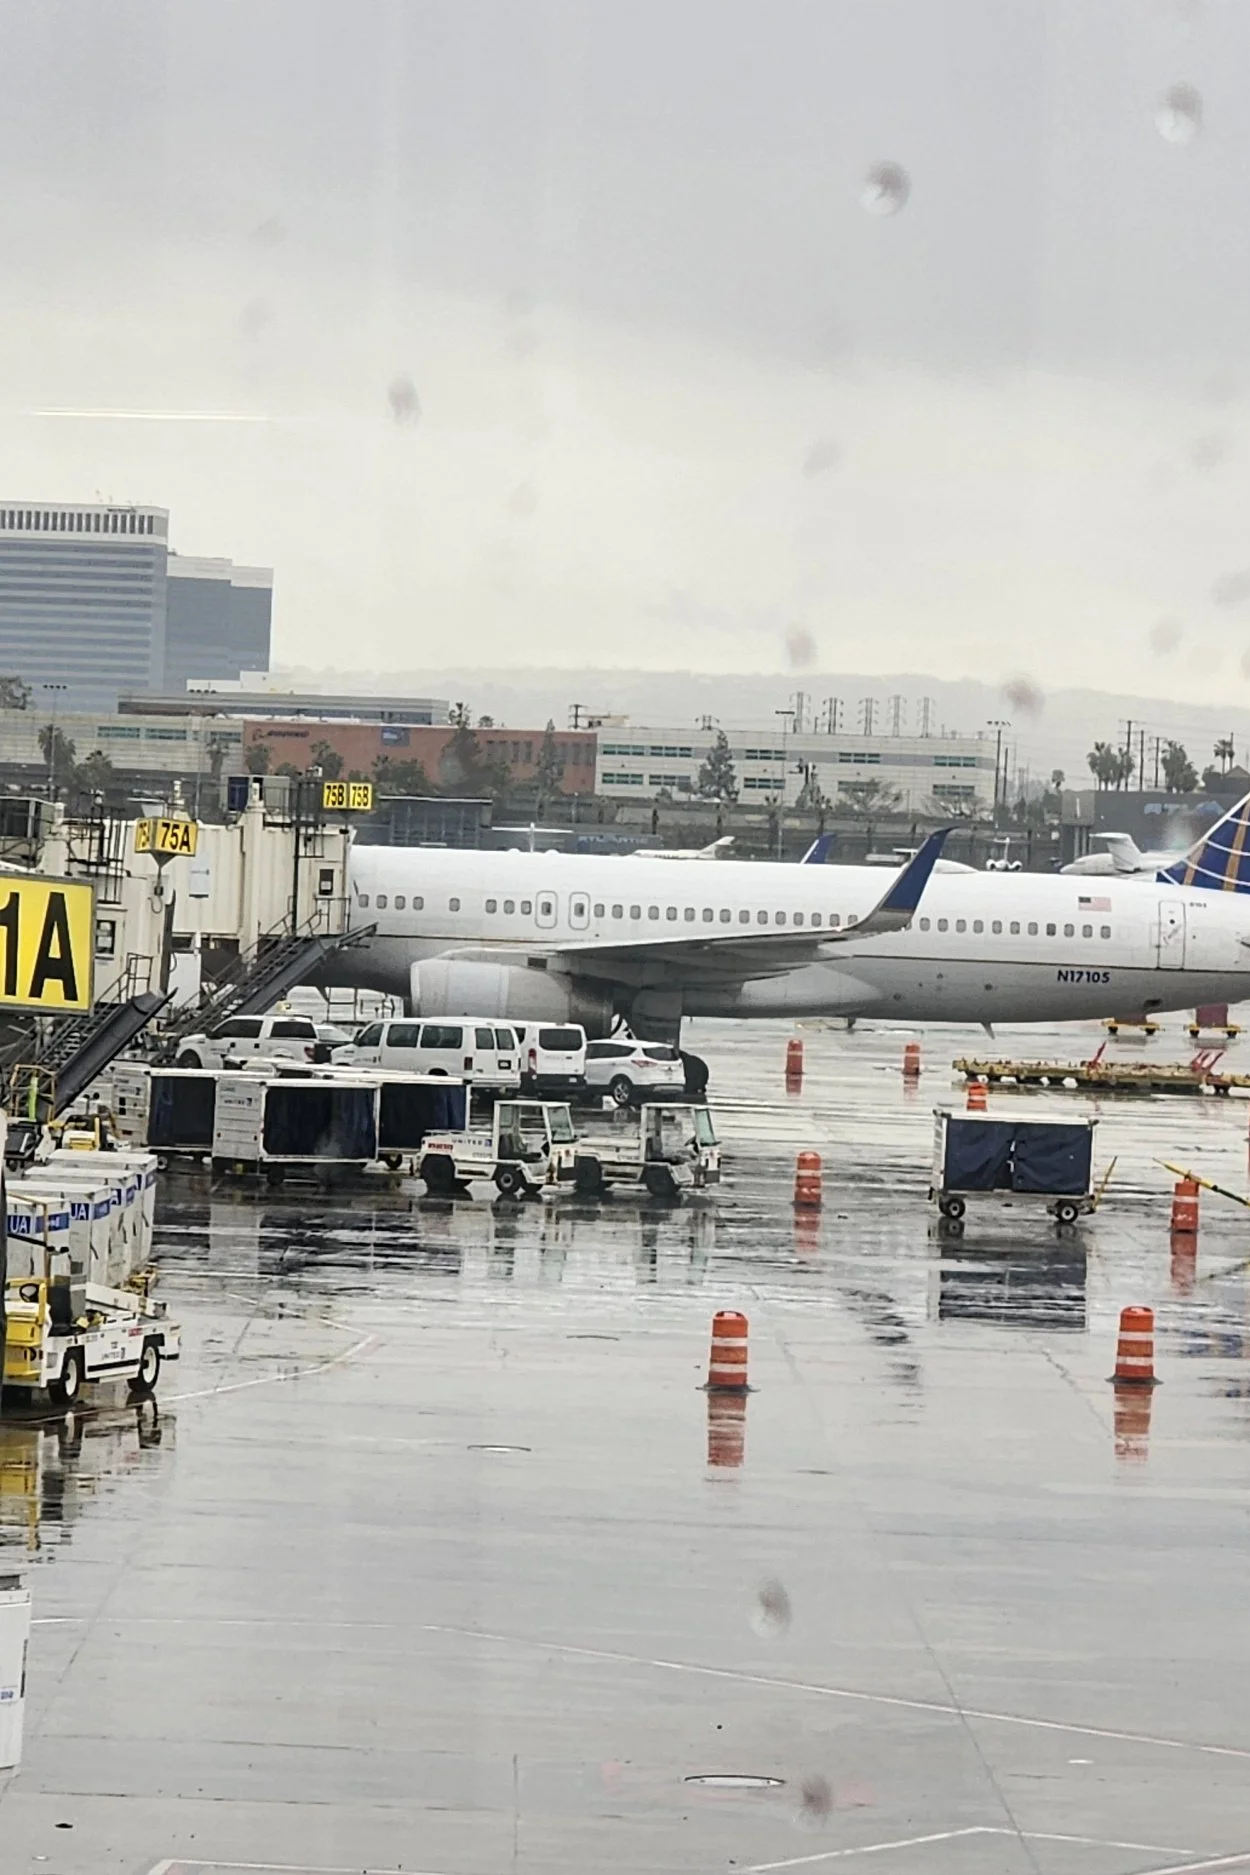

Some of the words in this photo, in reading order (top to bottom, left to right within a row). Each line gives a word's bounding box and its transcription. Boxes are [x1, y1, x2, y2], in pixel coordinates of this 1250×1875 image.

[326, 784, 345, 806] 75B
[352, 786, 369, 806] 75B
[161, 821, 191, 852] 75A
[0, 891, 79, 1002] 1A
[1057, 970, 1110, 984] N17105
[70, 1203, 87, 1220] UA
[10, 1217, 28, 1233] UA
